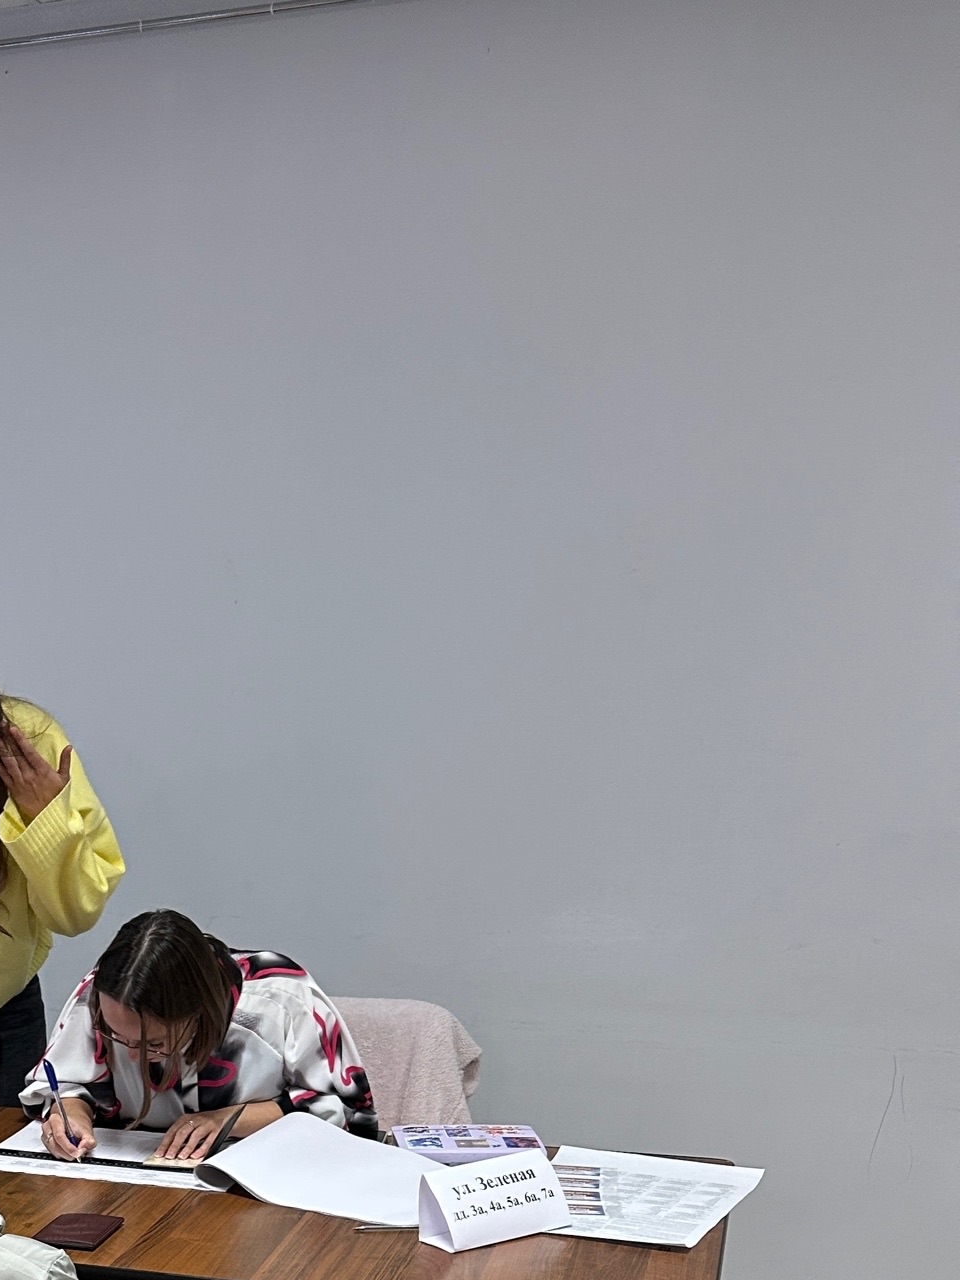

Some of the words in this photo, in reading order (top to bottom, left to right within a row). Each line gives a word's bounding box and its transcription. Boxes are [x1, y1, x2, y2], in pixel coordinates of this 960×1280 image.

[451, 1183, 476, 1201] ул.
[475, 1168, 537, 1191] Зеленая
[470, 1204, 488, 1217] 3а,
[489, 1200, 506, 1213] 4а,
[506, 1195, 524, 1208] 5а,
[524, 1191, 541, 1204] 6а,
[540, 1187, 555, 1200] 7а
